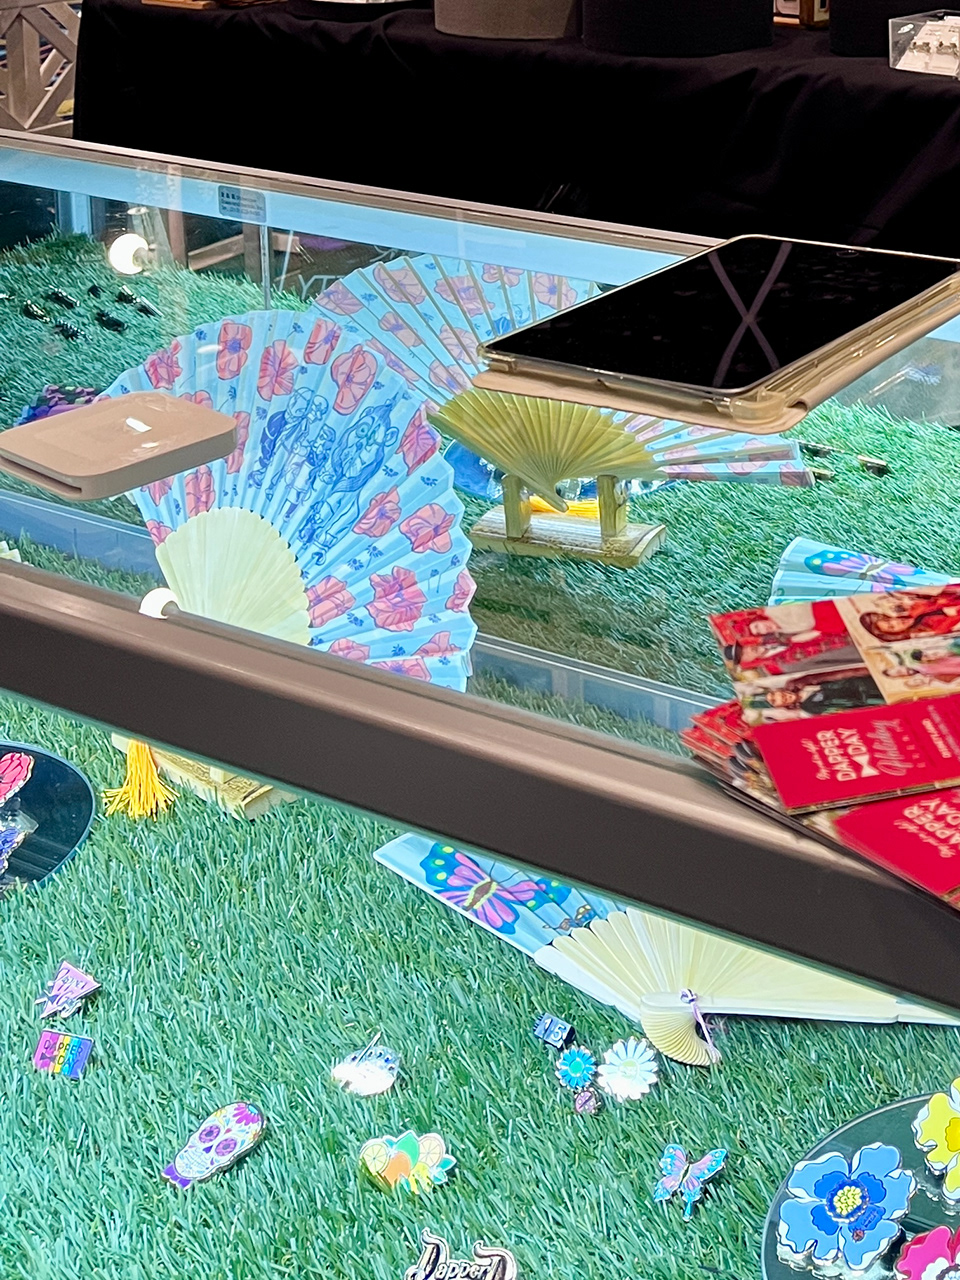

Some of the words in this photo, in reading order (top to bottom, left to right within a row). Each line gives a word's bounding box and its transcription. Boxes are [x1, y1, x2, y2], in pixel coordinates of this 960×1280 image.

[813, 728, 859, 782] DAPPER
[835, 725, 869, 755] DAY
[864, 718, 914, 775] Holiday
[543, 1017, 567, 1042] 15
